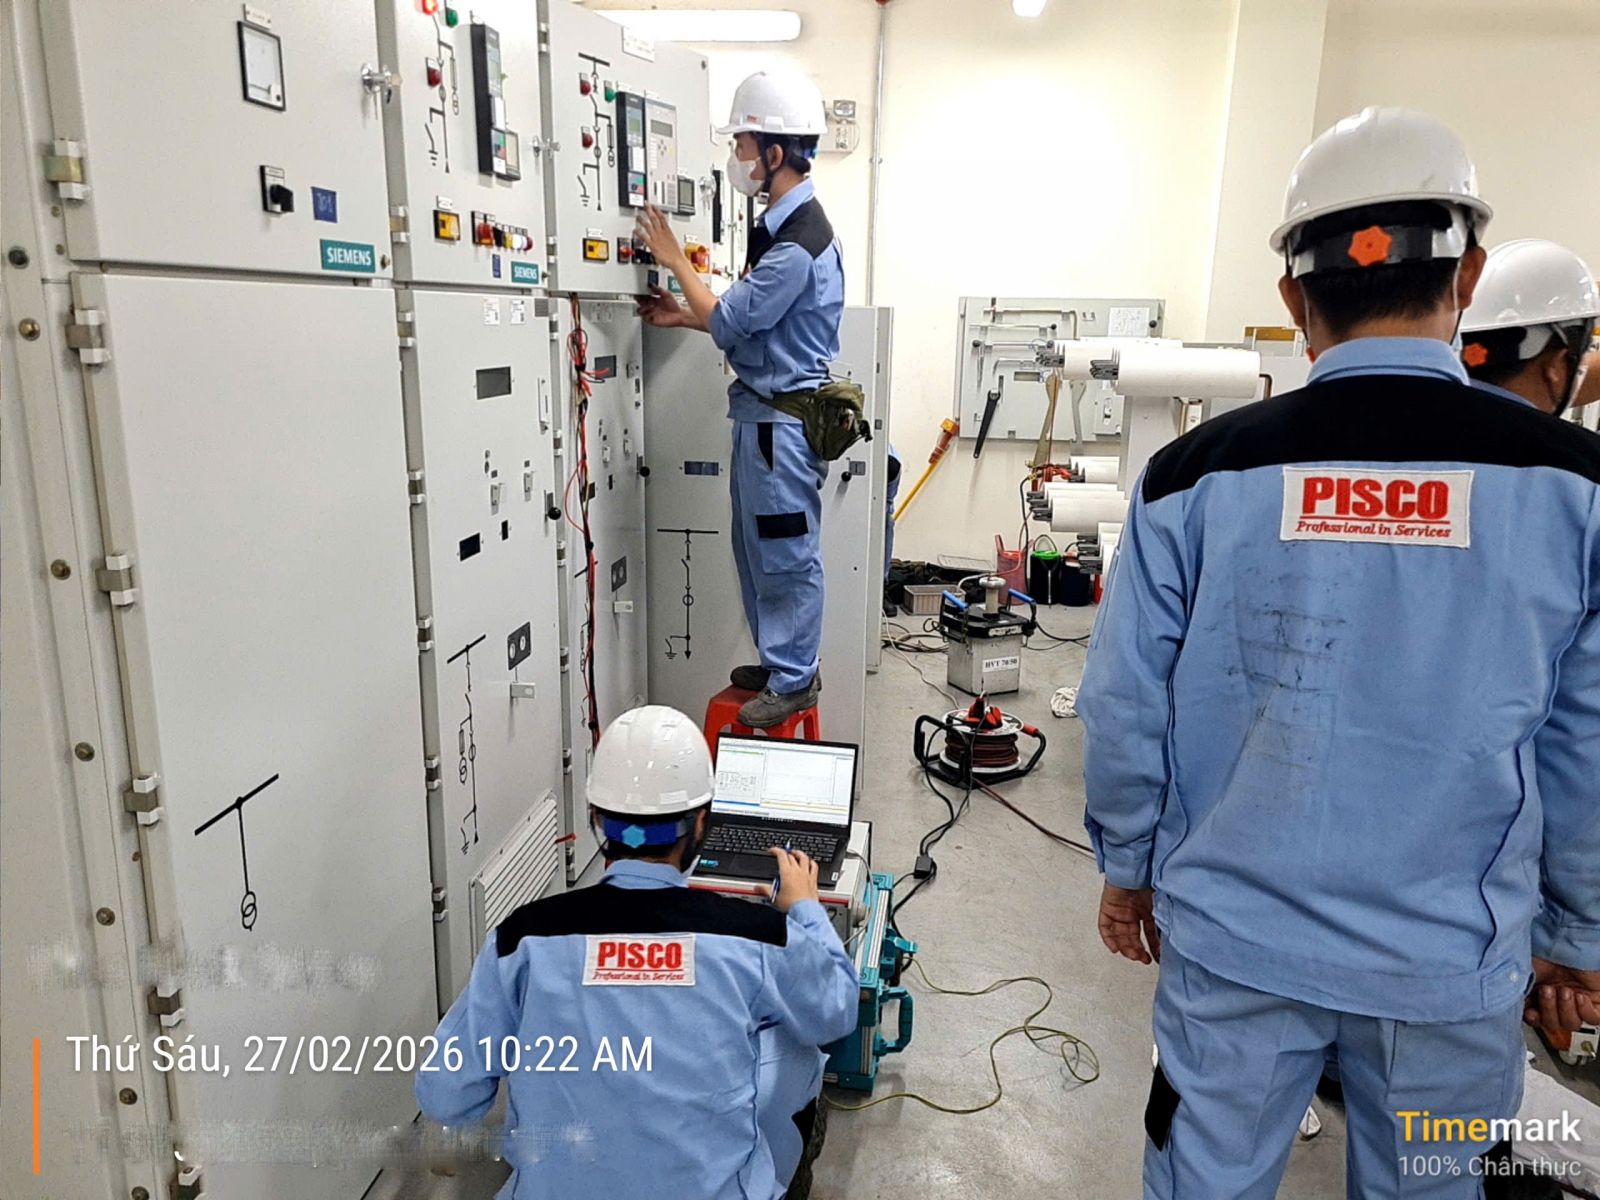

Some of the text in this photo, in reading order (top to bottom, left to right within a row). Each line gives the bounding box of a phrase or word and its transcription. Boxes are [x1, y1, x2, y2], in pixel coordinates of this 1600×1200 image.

[326, 247, 372, 266] SIEMENS
[1302, 477, 1449, 520] PISCO
[1295, 521, 1452, 537] Professional in Services
[597, 942, 682, 969] PISCO
